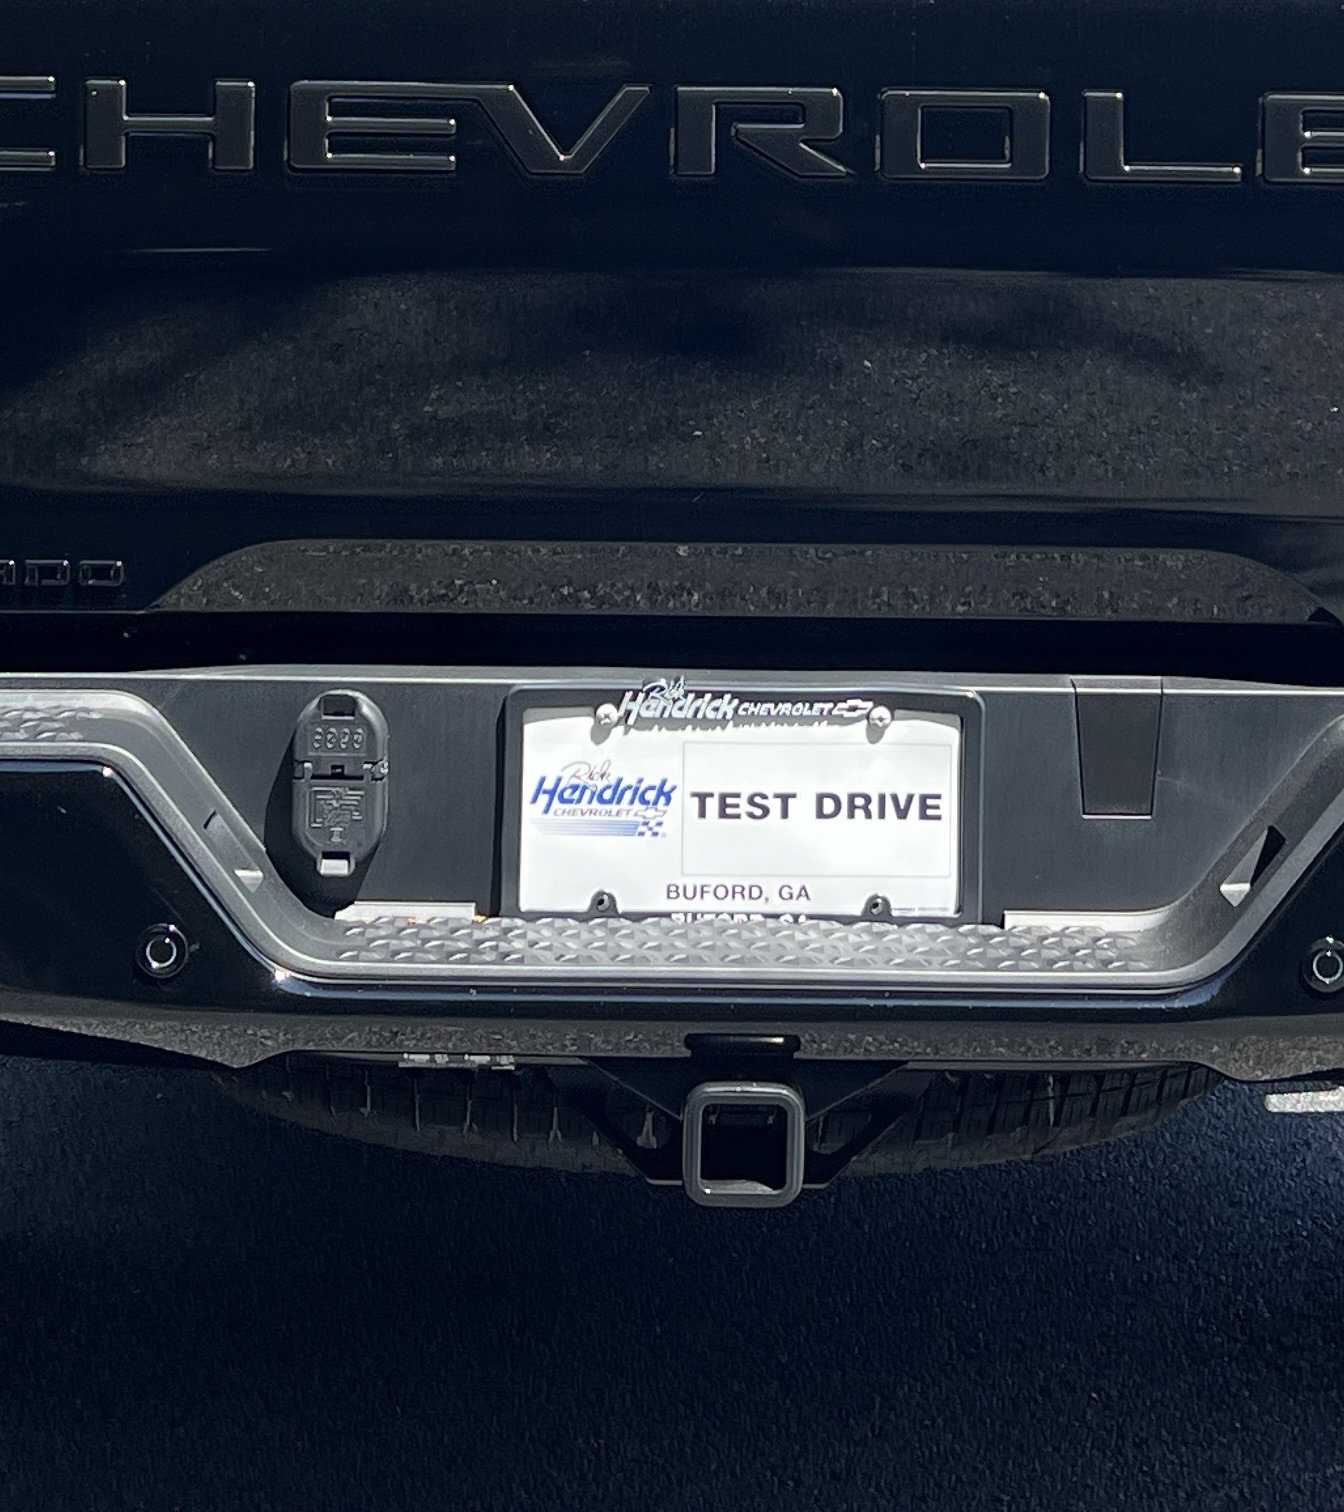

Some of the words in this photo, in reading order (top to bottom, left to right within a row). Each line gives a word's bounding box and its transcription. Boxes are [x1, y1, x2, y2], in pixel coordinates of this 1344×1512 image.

[617, 690, 739, 725] Hendrick
[737, 701, 834, 717] CHEVROLET
[560, 759, 613, 791] Rick
[529, 775, 678, 815] Hendrick
[690, 790, 798, 821] TEST
[814, 791, 943, 822] DRIVE
[553, 807, 633, 818] CHEVROLET
[665, 883, 771, 904] BUFORD,
[778, 883, 812, 902] GA
